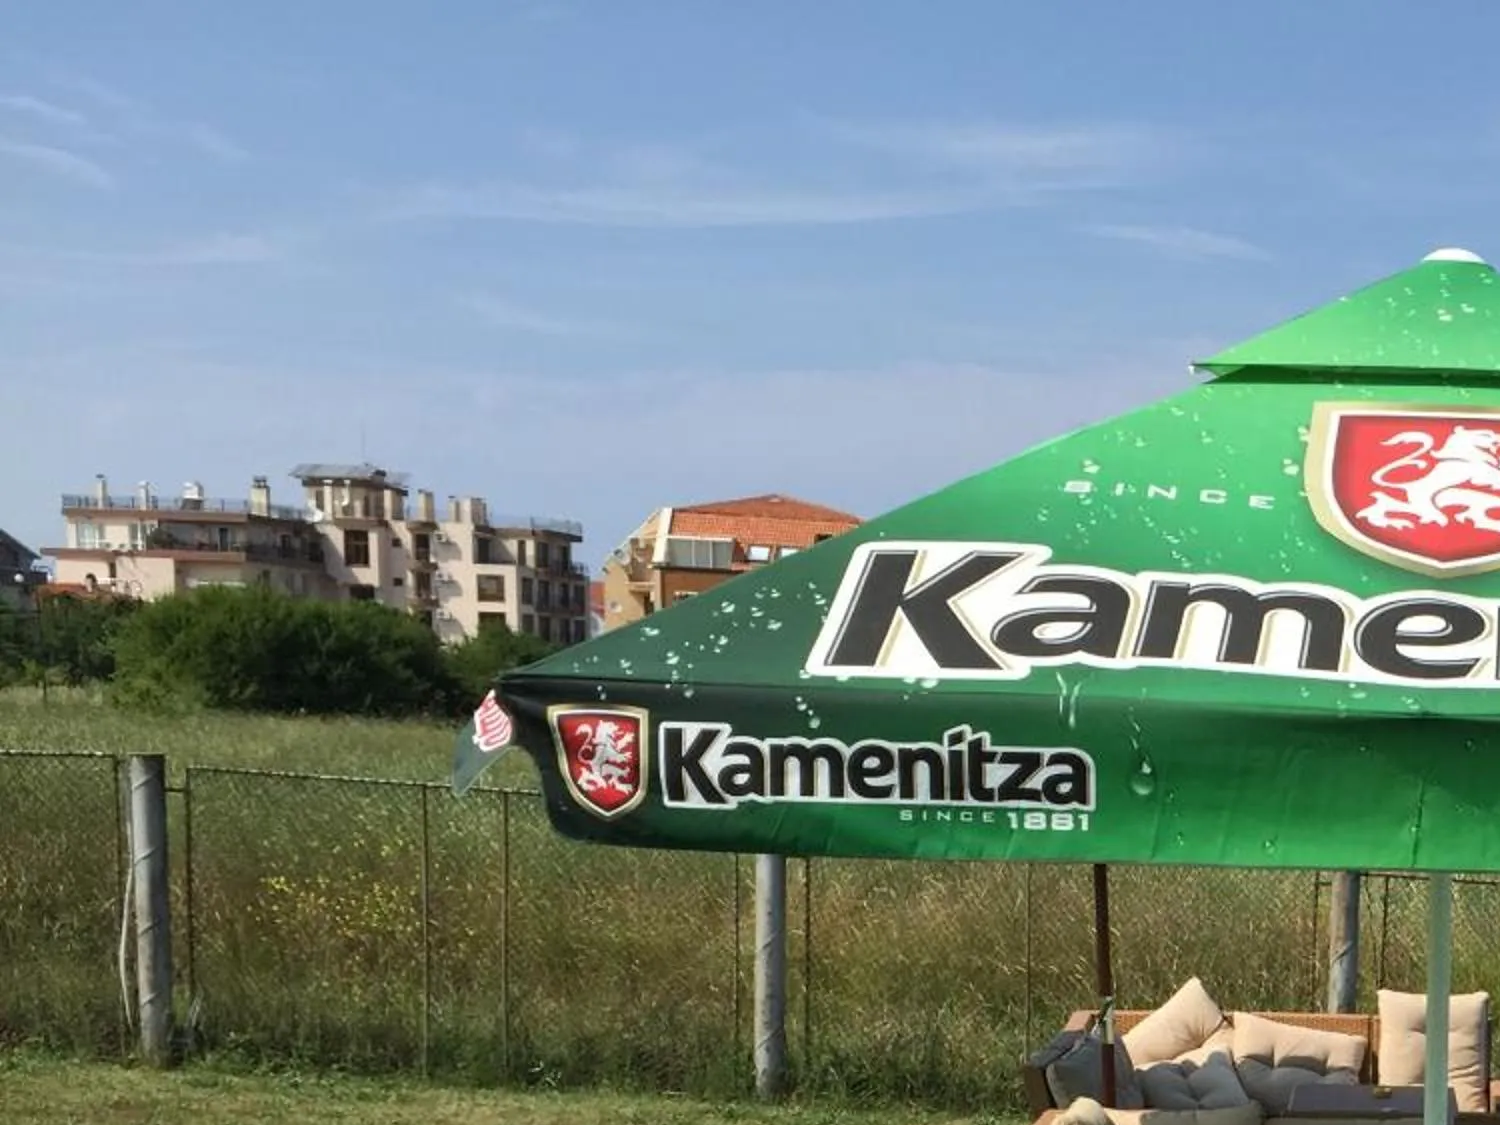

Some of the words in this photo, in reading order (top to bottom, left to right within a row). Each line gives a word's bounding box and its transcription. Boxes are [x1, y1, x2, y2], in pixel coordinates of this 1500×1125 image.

[1064, 480, 1276, 510] SINCE
[661, 724, 1090, 806] Kamenitza
[899, 809, 995, 824] SINCE
[1006, 812, 1089, 832] 1881
